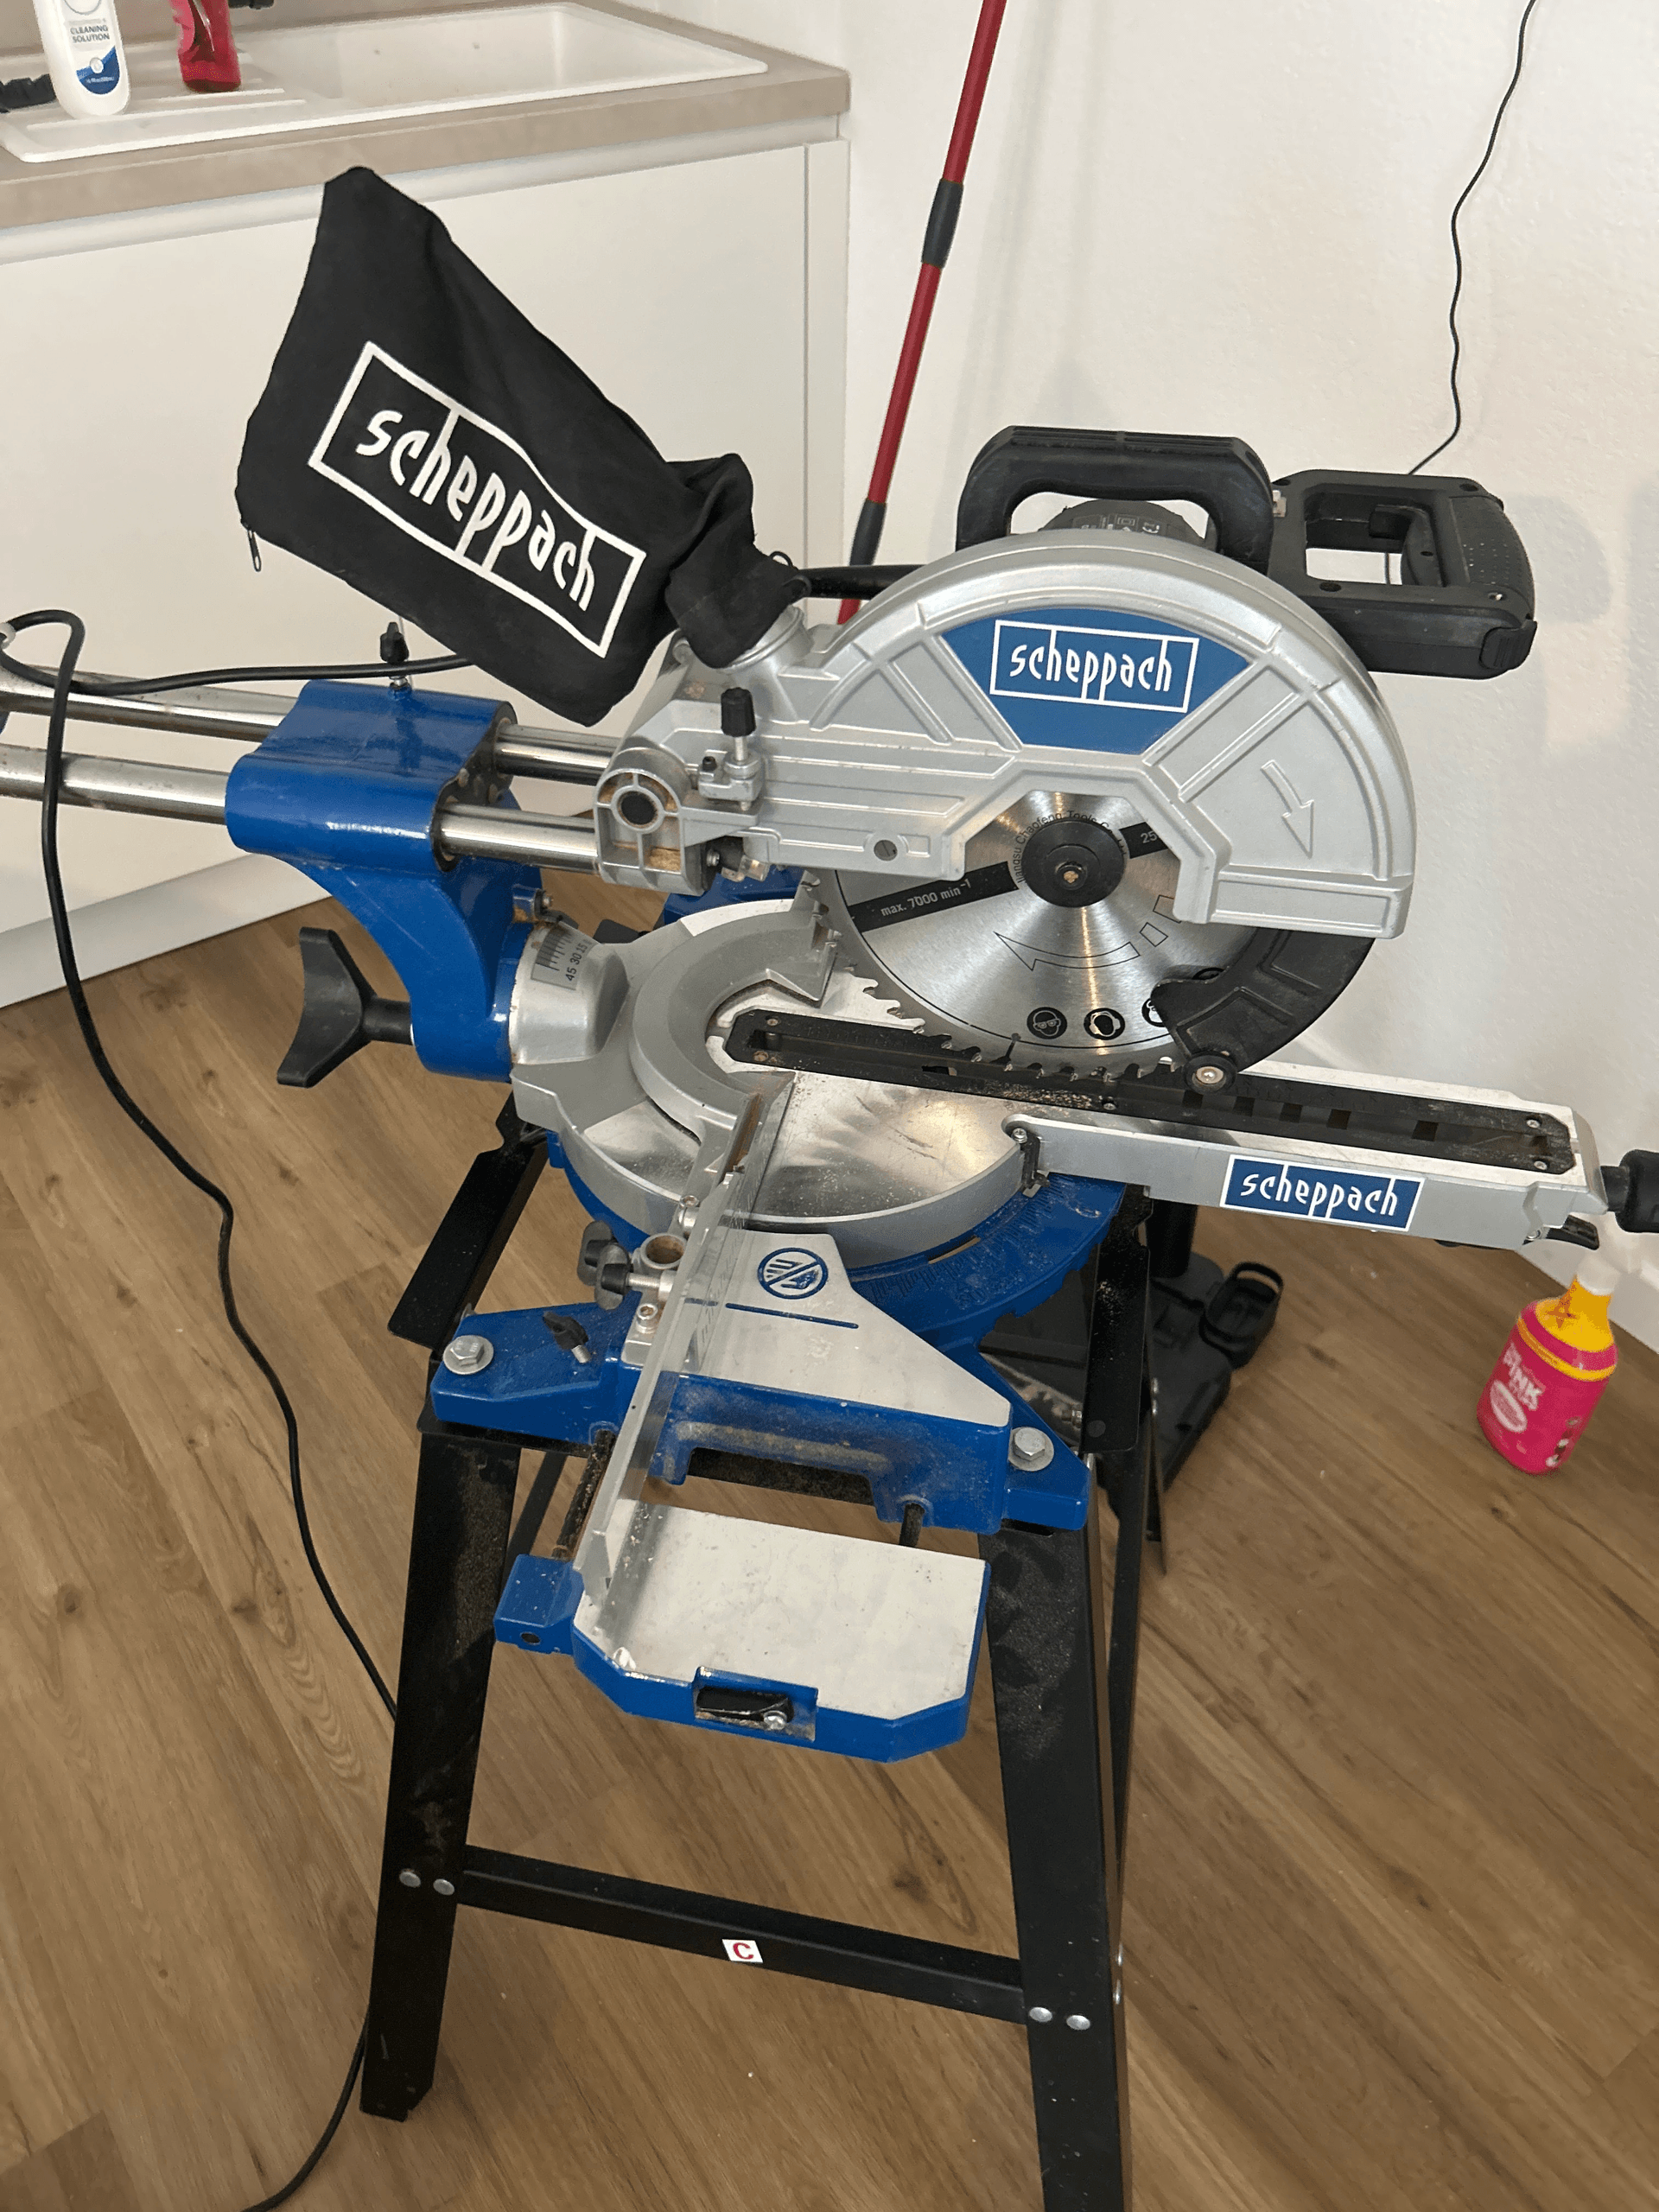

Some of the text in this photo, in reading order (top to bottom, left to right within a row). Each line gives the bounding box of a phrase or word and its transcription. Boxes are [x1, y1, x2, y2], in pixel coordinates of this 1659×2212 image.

[70, 25, 108, 35] CLEANING
[72, 33, 110, 43] SOLUTION
[355, 406, 596, 611] scheppach
[1009, 629, 1173, 701] scheppach
[880, 904, 906, 916] max.
[907, 893, 938, 908] 7000
[569, 953, 582, 965] 30
[565, 967, 576, 981] 45
[1240, 1165, 1398, 1218] scheppach
[733, 1942, 753, 1960] C
